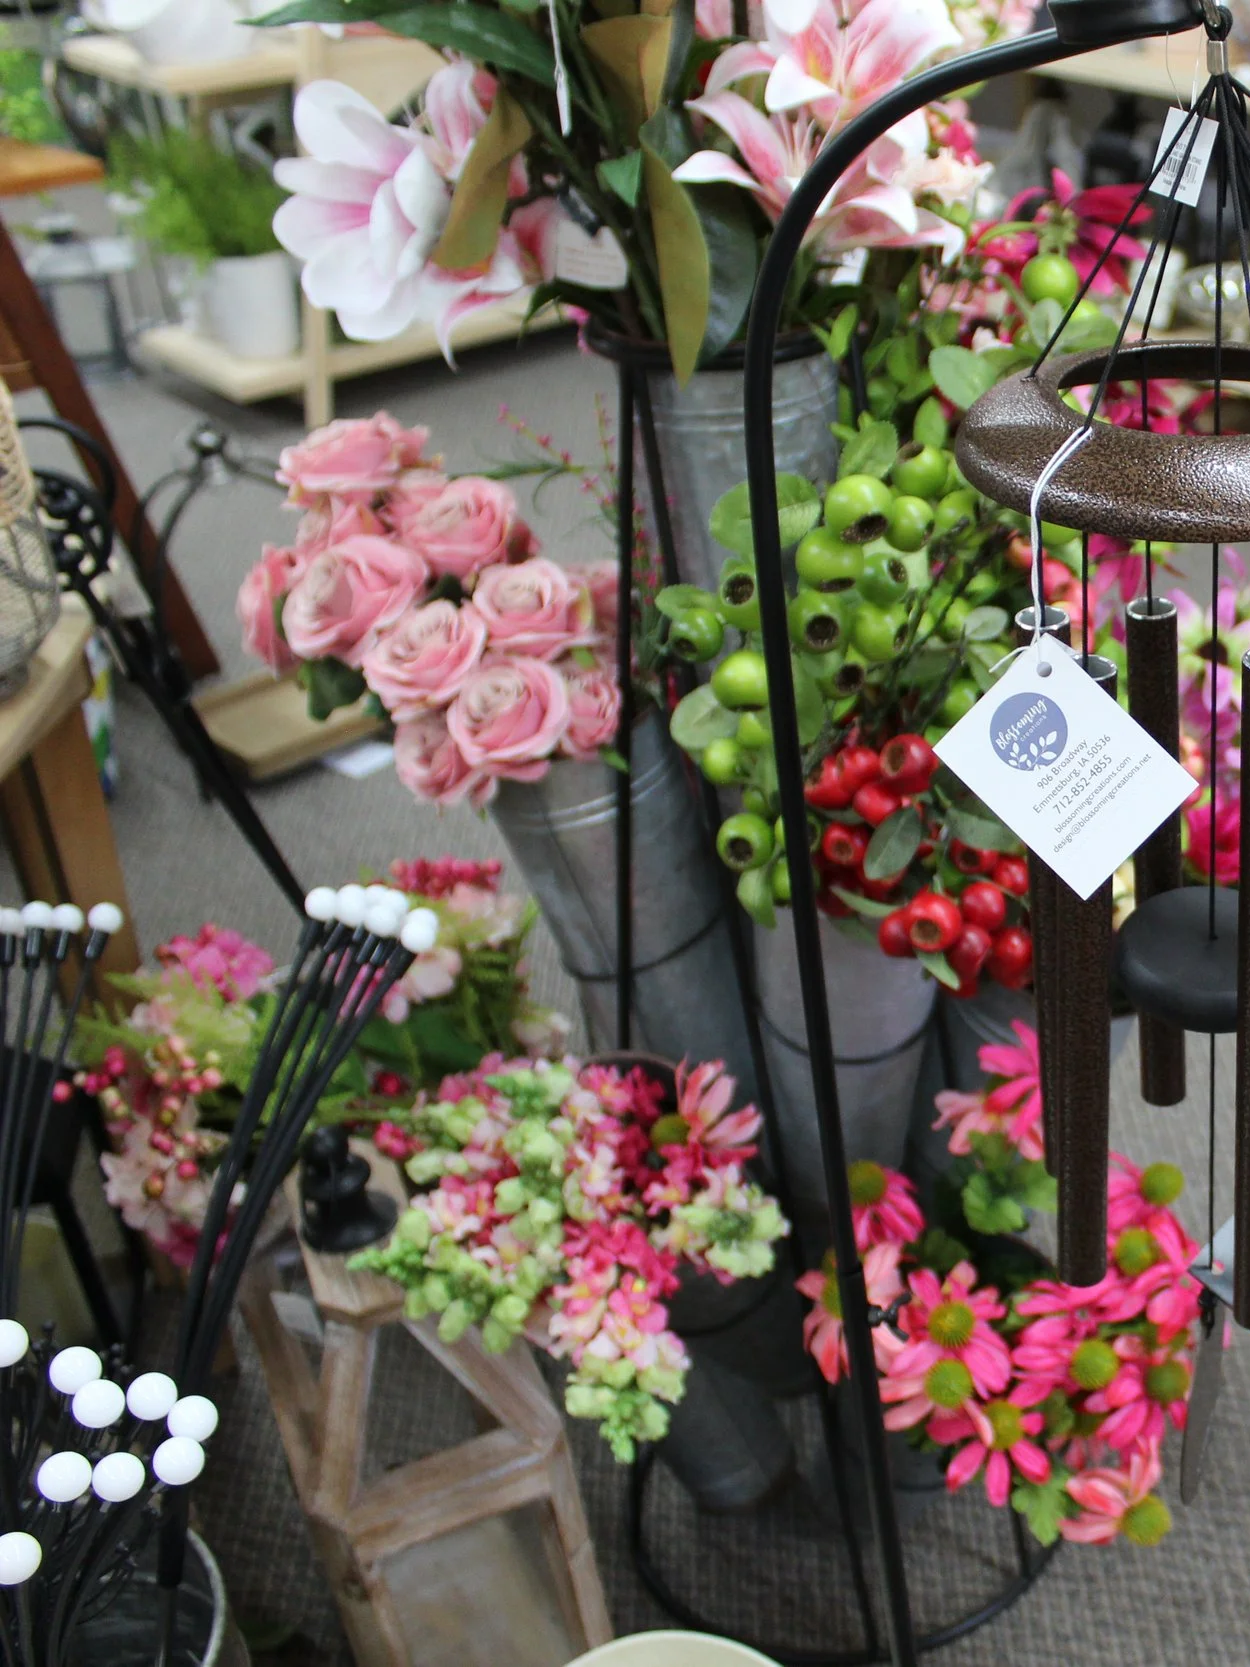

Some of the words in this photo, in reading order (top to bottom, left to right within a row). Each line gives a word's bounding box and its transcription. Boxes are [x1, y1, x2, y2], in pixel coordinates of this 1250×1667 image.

[995, 697, 1048, 751] Blossoming
[1019, 714, 1048, 742] creations
[1032, 768, 1081, 814] Emmetsburg,
[1078, 757, 1090, 769] IA
[1086, 734, 1112, 759] 50536
[1036, 774, 1053, 790] 906
[1051, 739, 1088, 776] Broadway
[1052, 754, 1113, 815] 712-852-4855
[1054, 755, 1132, 834] blossomingcreations.com
[1053, 753, 1152, 853] design@blossomingcreations.net
